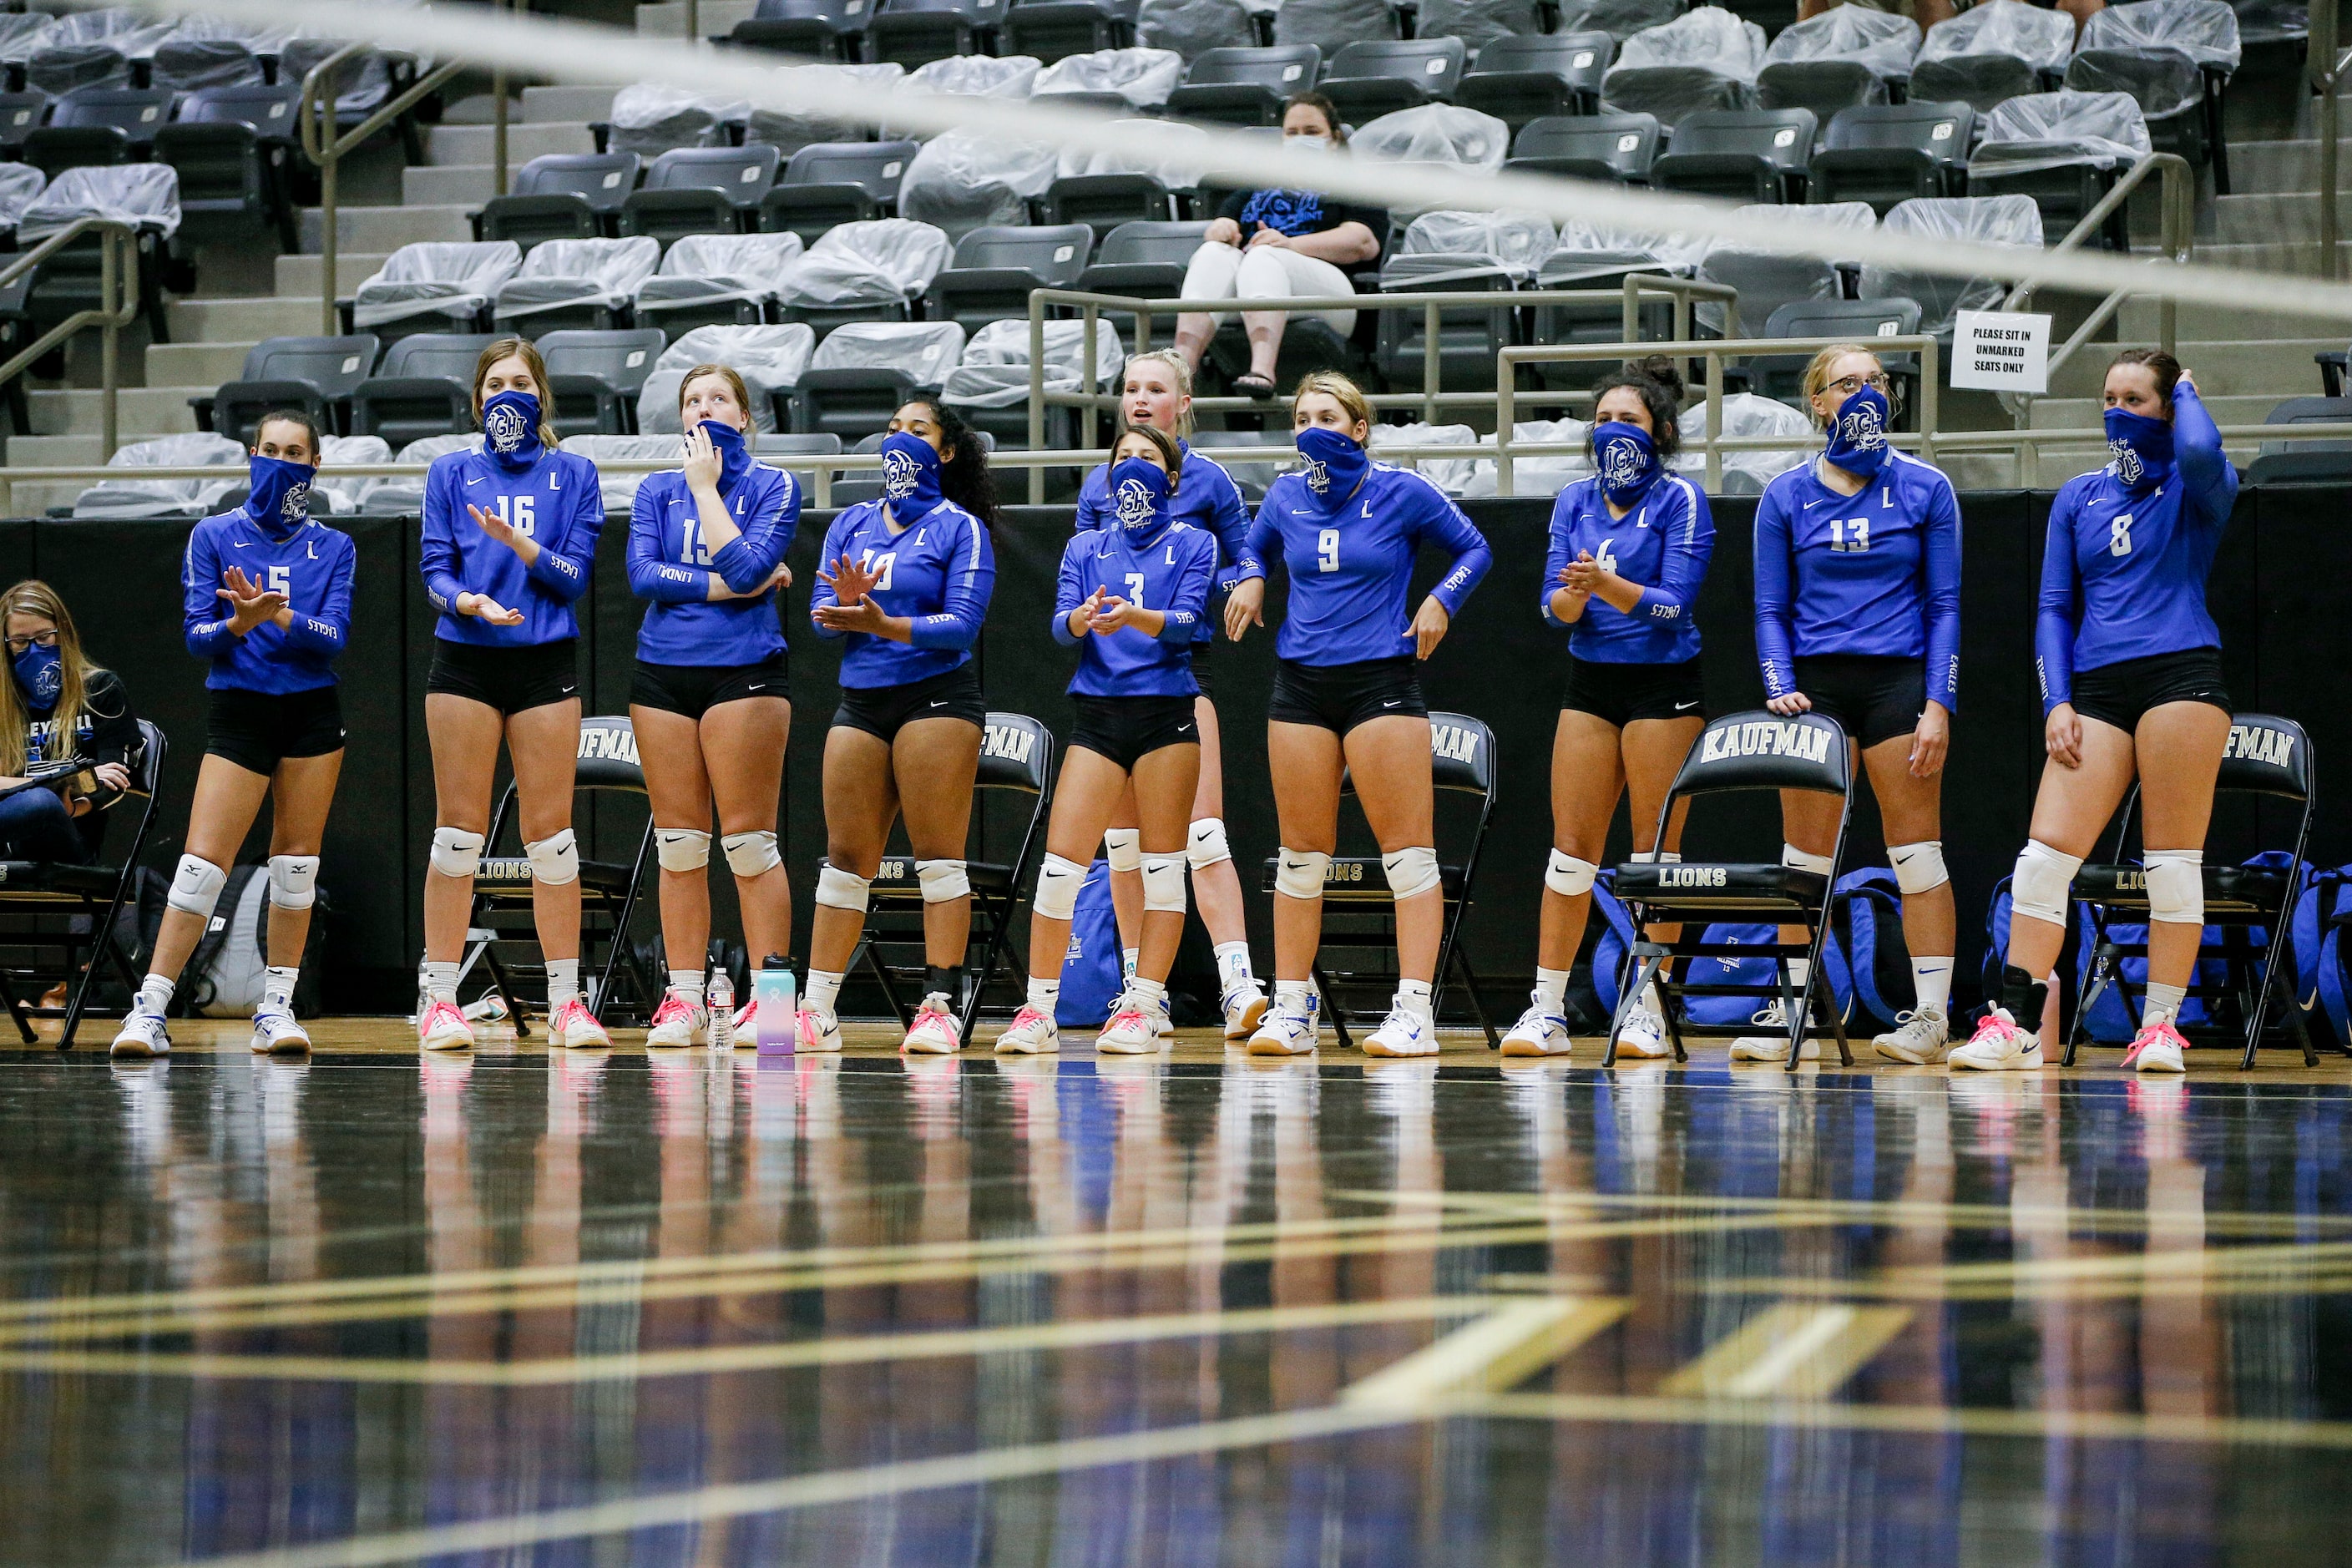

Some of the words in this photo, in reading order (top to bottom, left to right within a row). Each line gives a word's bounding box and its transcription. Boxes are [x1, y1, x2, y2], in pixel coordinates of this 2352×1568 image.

[1973, 328, 2004, 339] PLEASE
[2006, 330, 2021, 340] SIT
[2021, 331, 2031, 341] IN
[1976, 344, 2025, 357] UNMARKED
[1975, 361, 2000, 372] SEATS
[2003, 362, 2024, 373] ONLY
[549, 472, 561, 490] L
[736, 495, 746, 515] L
[1882, 486, 1894, 508] L
[497, 495, 535, 537] 16
[1361, 499, 1373, 518] L
[1636, 506, 1649, 528] L
[914, 528, 928, 546] L
[1829, 517, 1870, 553] 13
[2109, 513, 2133, 557] 8
[307, 541, 319, 560] L
[1165, 545, 1176, 565] L
[1318, 529, 1340, 573] 9
[1596, 538, 1618, 575] 4
[551, 555, 579, 579] EAGLES
[268, 565, 291, 608] 5
[1444, 565, 1472, 592] EAGLES
[1124, 572, 1145, 609] 3
[307, 619, 338, 640] EAGLES
[1946, 654, 1959, 694] EAGLES
[1700, 721, 1833, 765] KAUFMAN
[2222, 725, 2294, 768] FMAN
[473, 862, 533, 879] LIONS
[1323, 863, 1363, 882] ONS
[1658, 867, 1727, 888] LIONS
[2115, 871, 2147, 891] LIO
